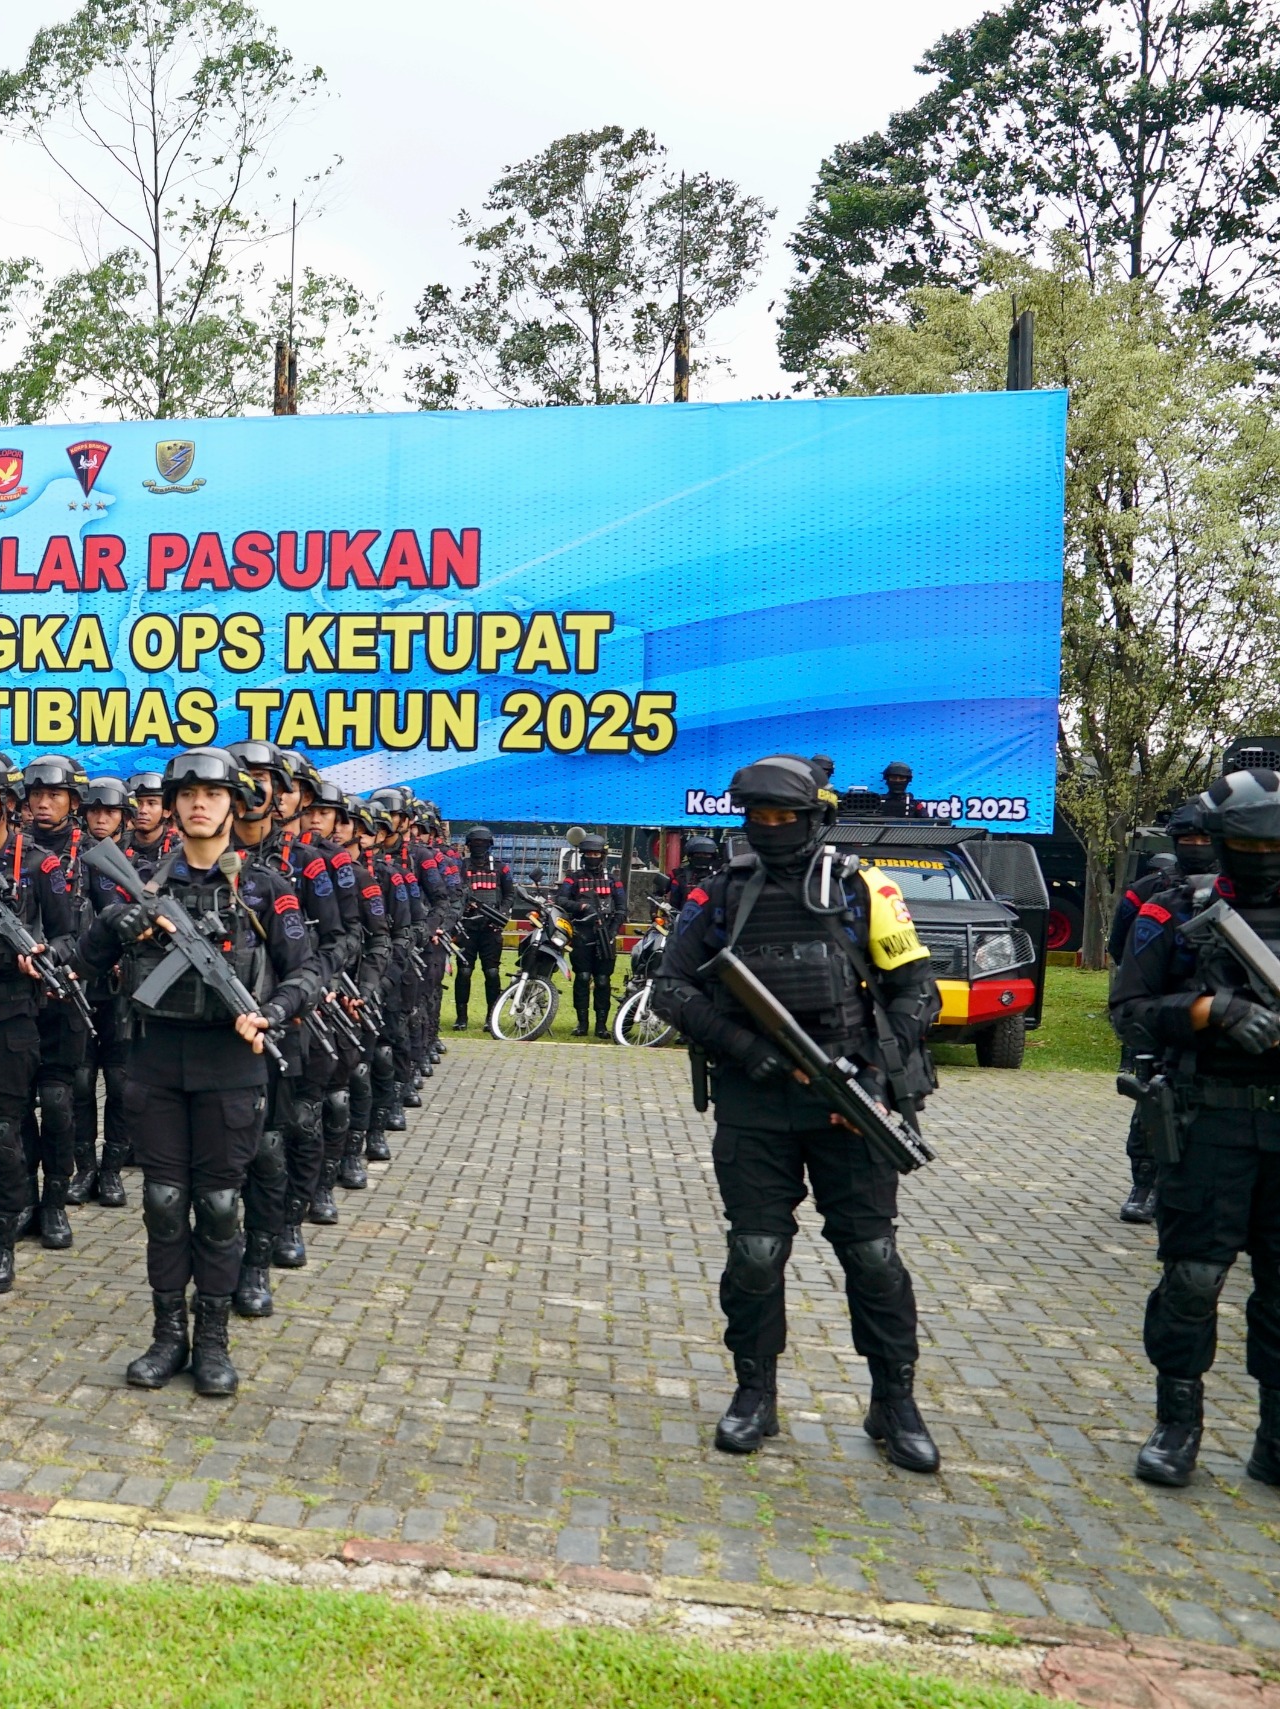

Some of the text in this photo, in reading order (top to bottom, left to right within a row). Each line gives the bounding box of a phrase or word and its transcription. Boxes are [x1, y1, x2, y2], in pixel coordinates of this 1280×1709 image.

[147, 527, 481, 590] PASUKAN
[129, 612, 263, 673] OPS
[285, 613, 614, 673] KETUPAT
[236, 690, 478, 750] TAHUN
[500, 690, 676, 754] 2025
[969, 798, 1027, 822] 2025
[874, 858, 945, 870] BRIMOB
